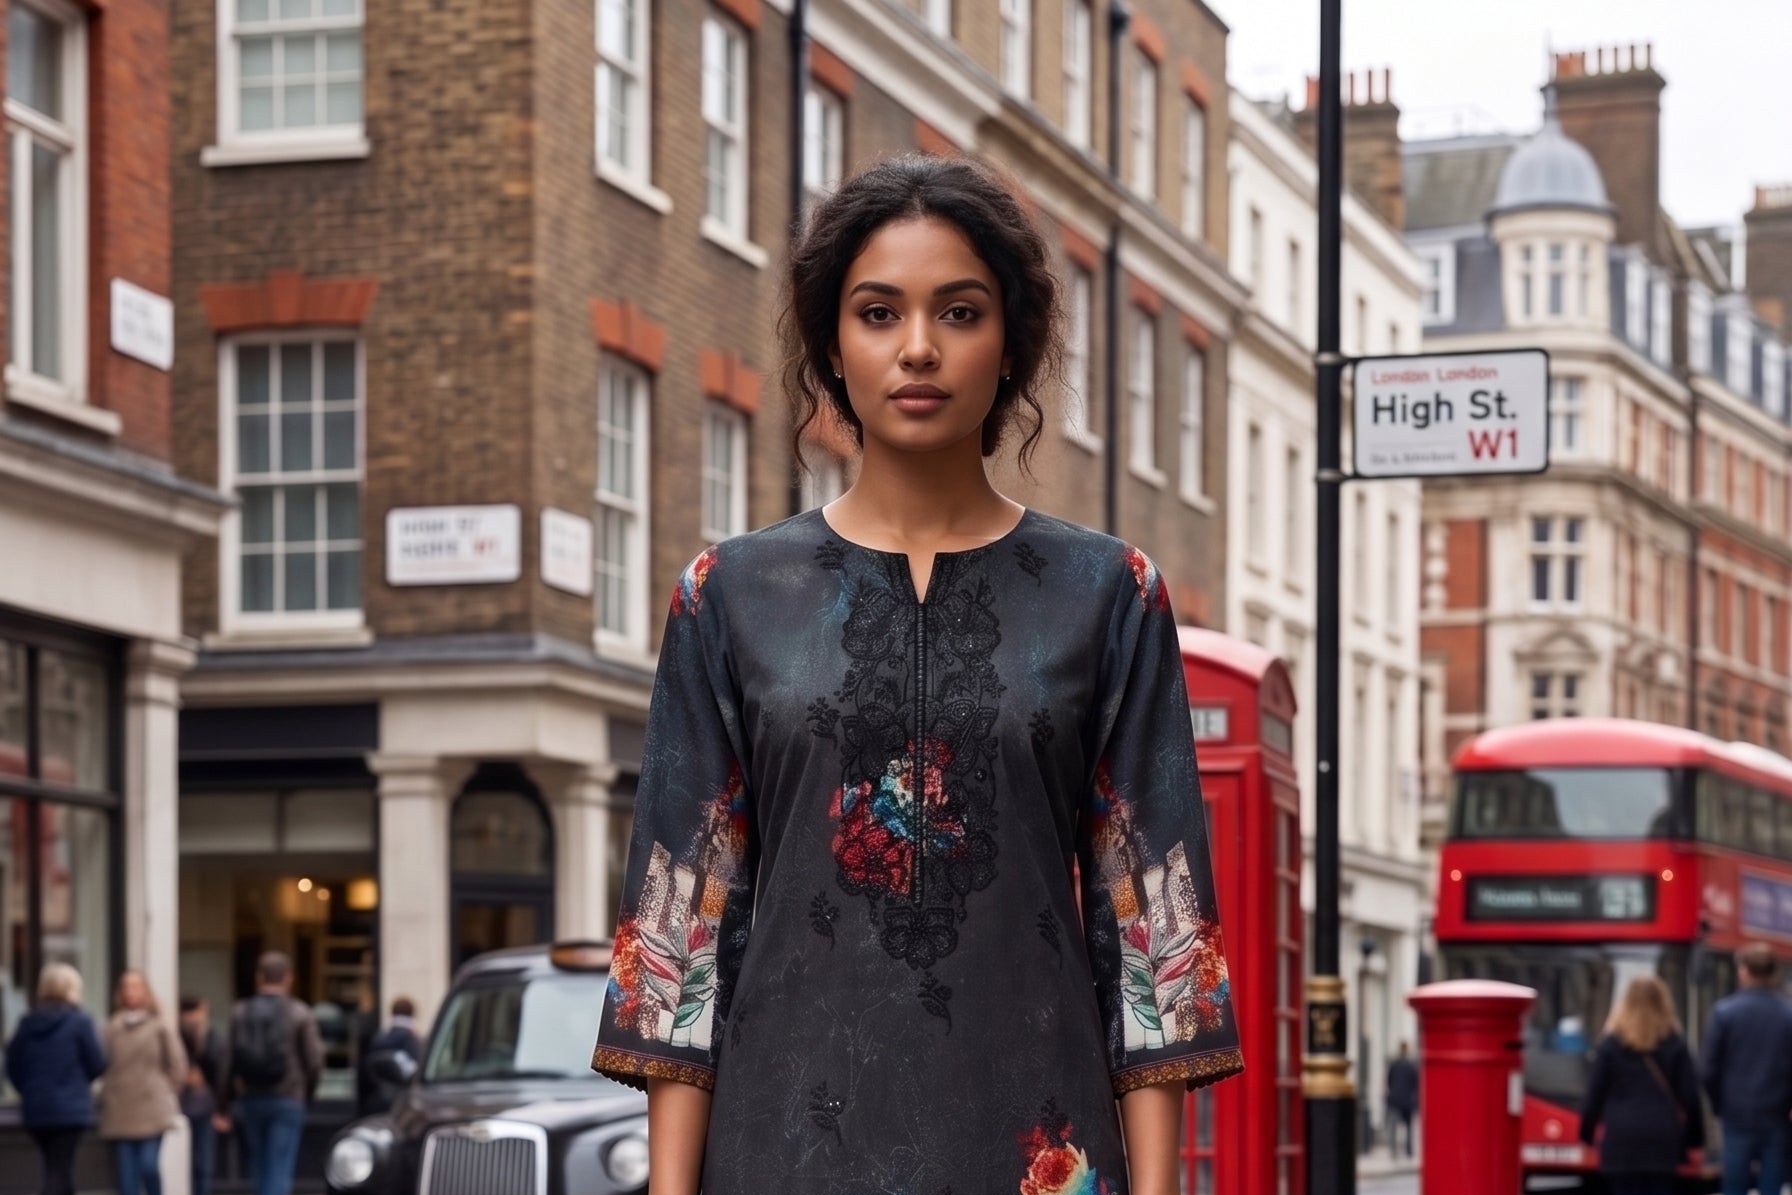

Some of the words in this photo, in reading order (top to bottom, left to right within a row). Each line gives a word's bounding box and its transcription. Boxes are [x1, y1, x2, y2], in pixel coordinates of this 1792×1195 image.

[1371, 369, 1429, 385] London
[1436, 366, 1497, 381] London
[1372, 392, 1453, 429] High
[1469, 389, 1517, 420] St.
[1467, 428, 1518, 460] W1
